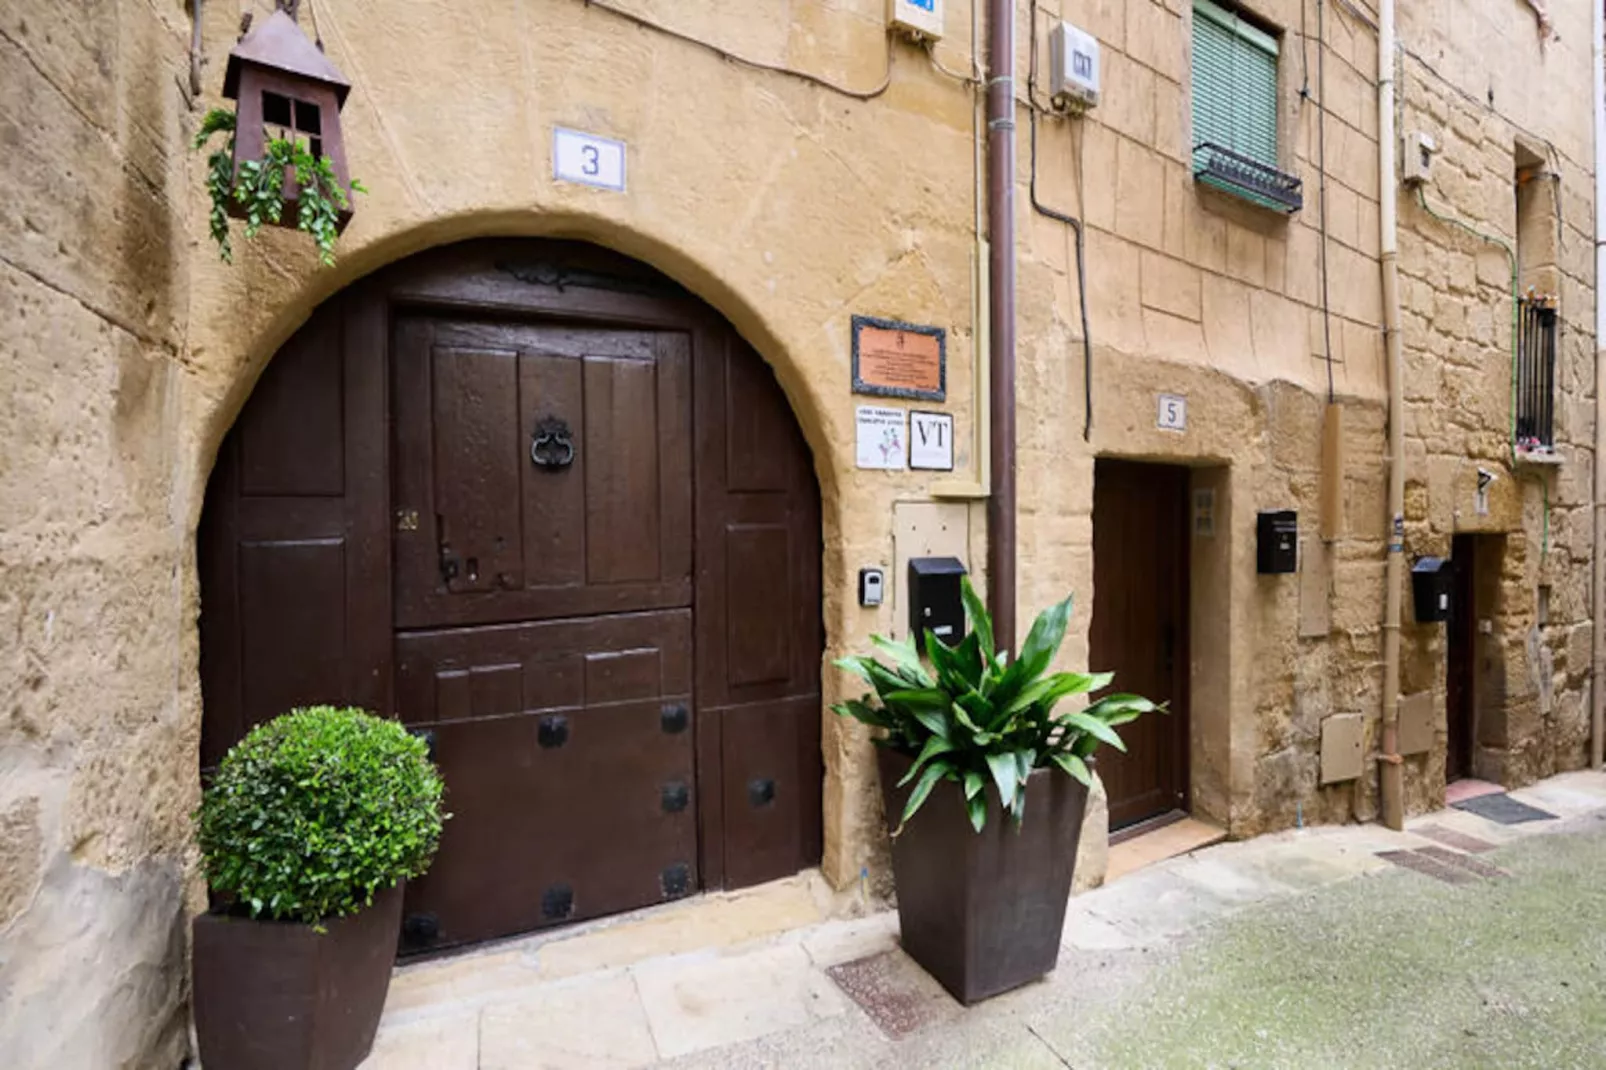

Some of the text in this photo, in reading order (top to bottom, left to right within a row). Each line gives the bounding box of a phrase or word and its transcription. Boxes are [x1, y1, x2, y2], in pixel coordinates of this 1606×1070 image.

[581, 144, 599, 175] 3
[1167, 402, 1177, 424] 5
[917, 420, 948, 448] VT
